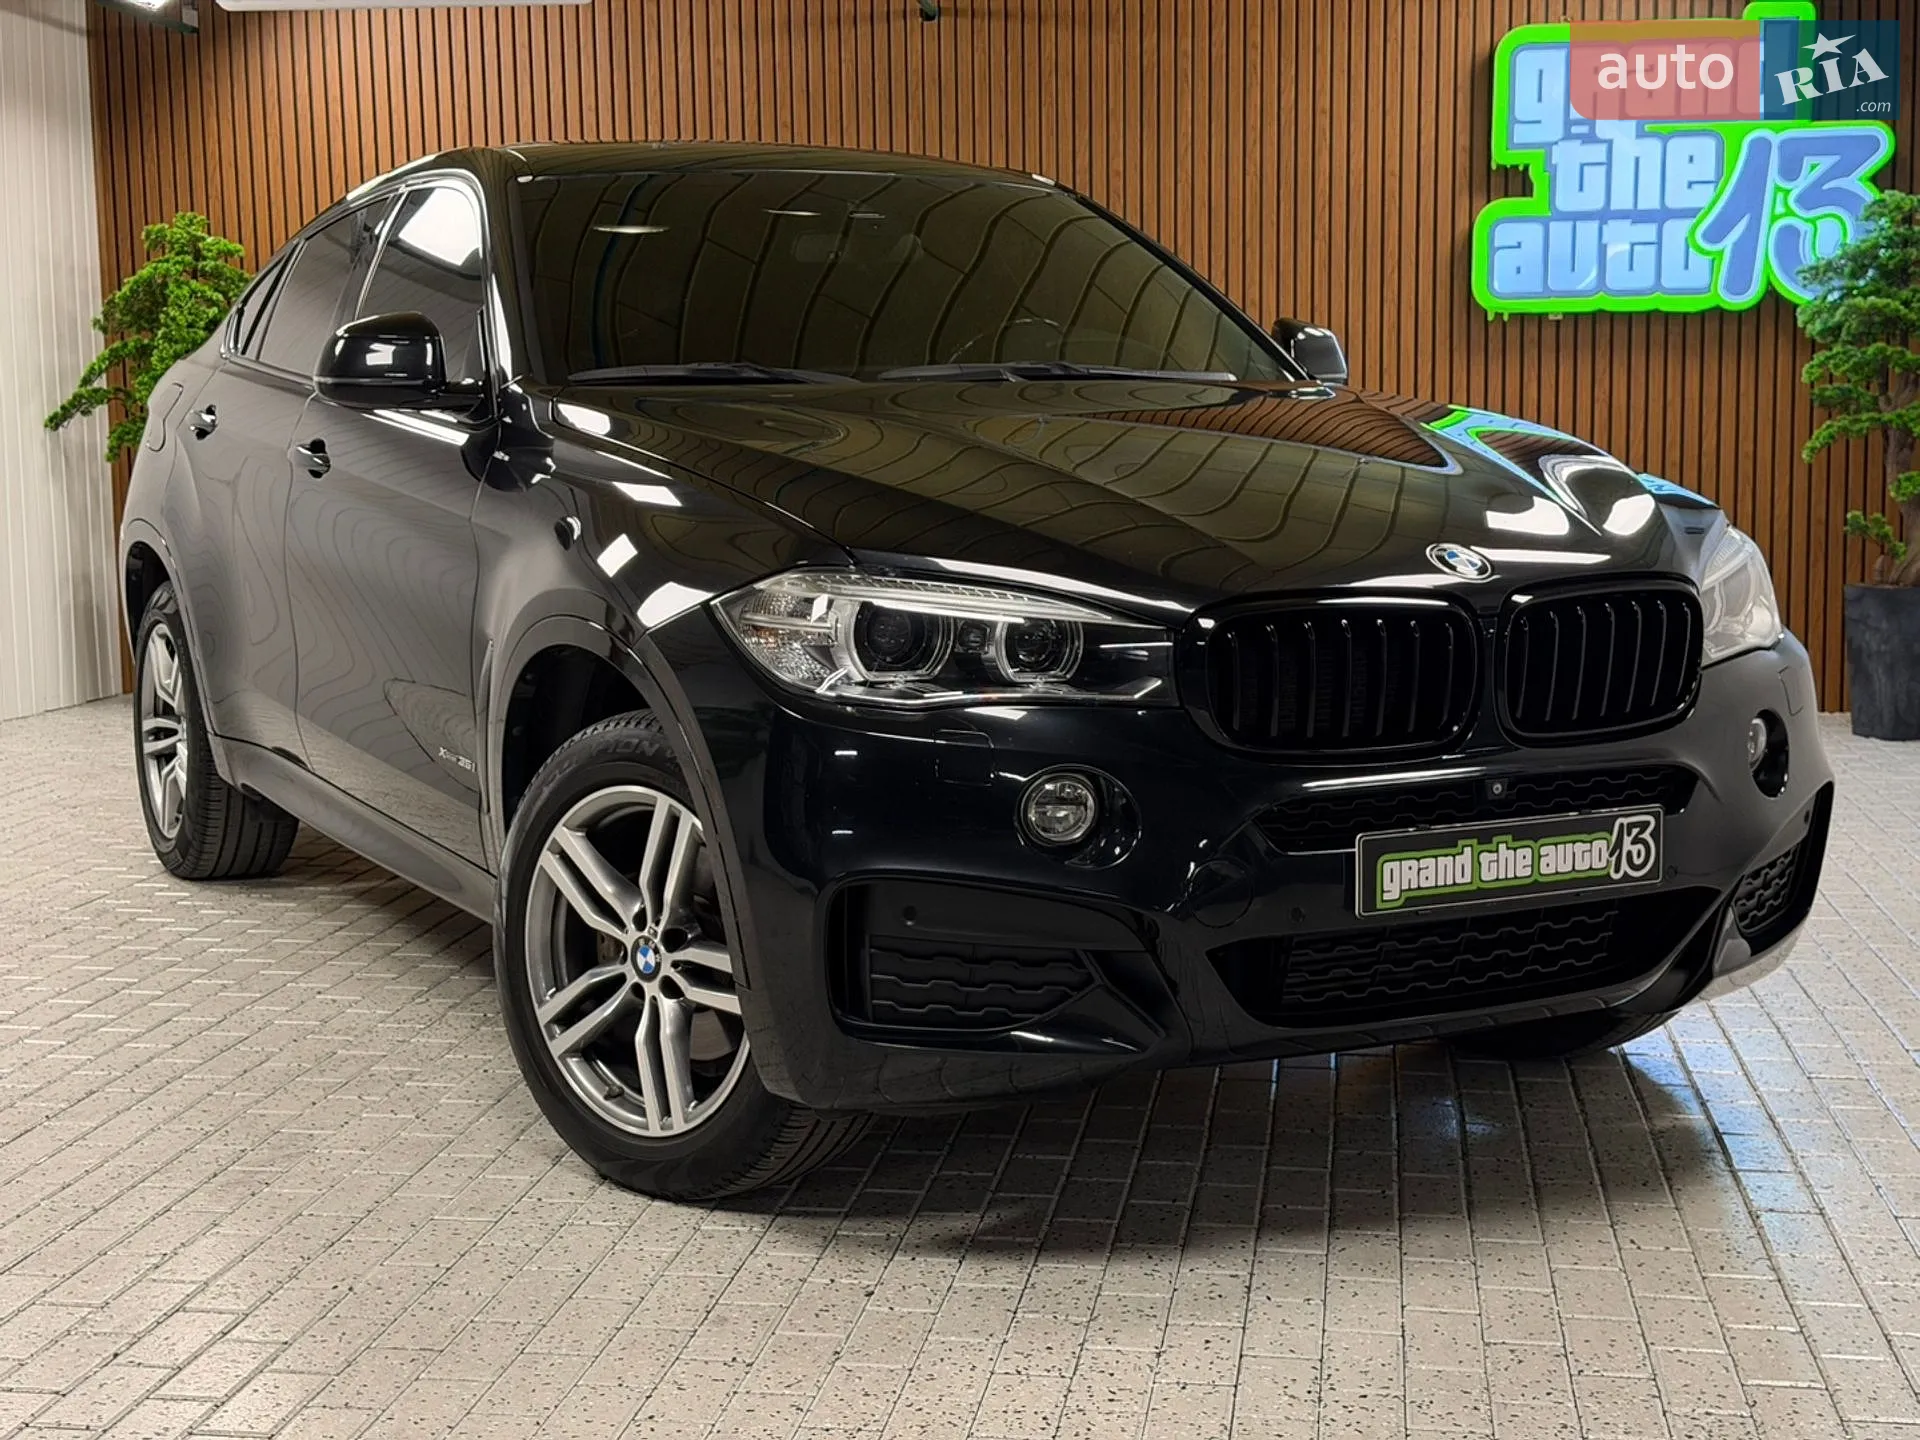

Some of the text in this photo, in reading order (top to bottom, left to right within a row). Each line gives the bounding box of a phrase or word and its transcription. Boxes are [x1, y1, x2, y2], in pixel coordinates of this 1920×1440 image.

[1552, 119, 1720, 212] the
[1493, 218, 1713, 294] auto
[1478, 842, 1533, 882] the
[1539, 839, 1609, 876] auto
